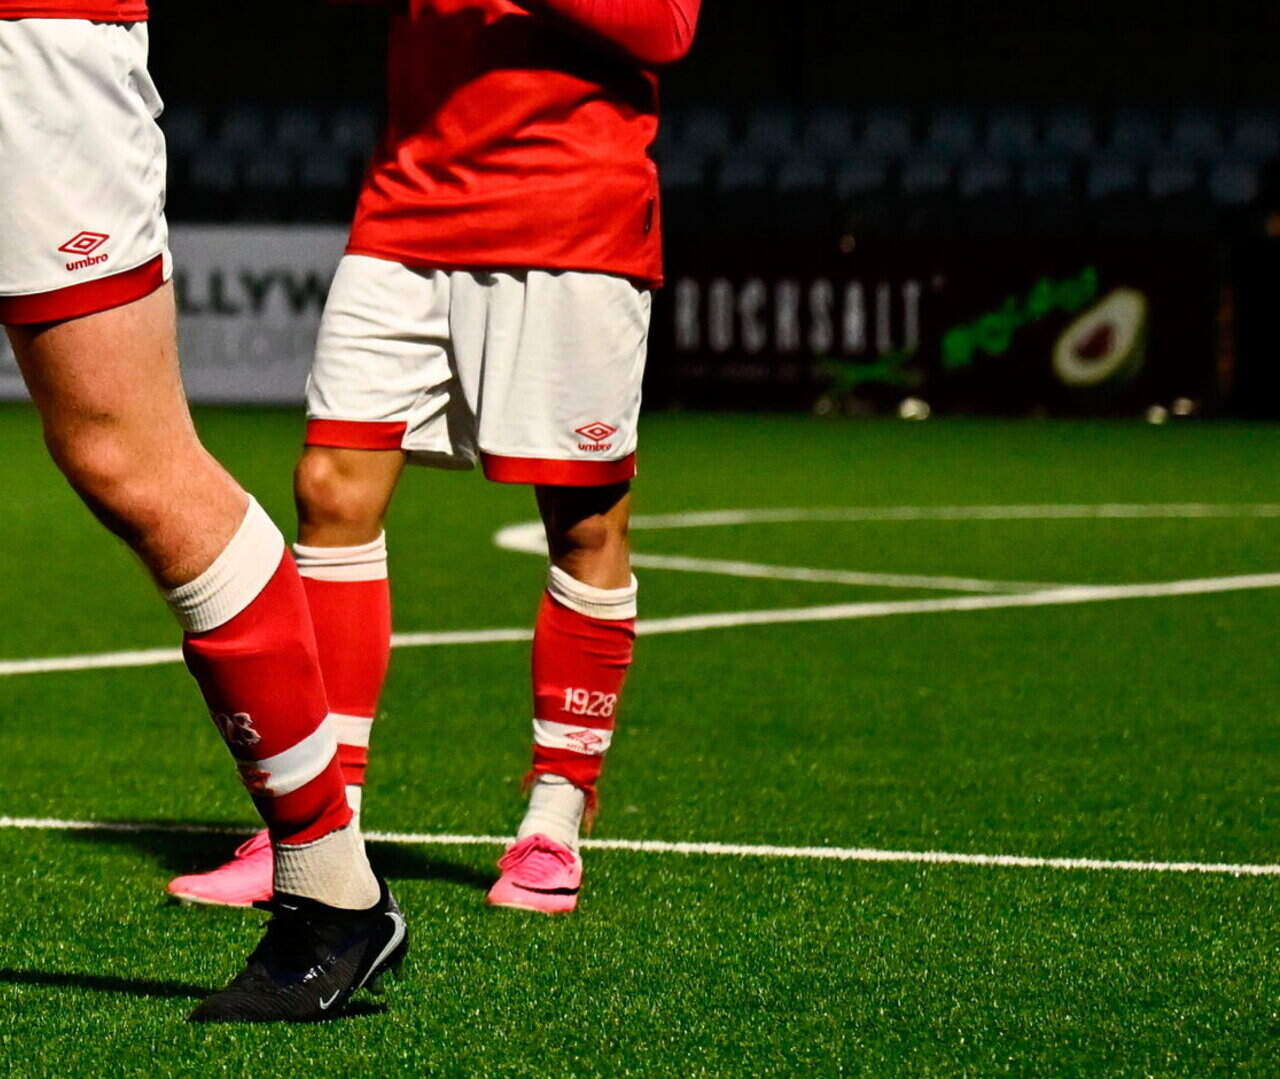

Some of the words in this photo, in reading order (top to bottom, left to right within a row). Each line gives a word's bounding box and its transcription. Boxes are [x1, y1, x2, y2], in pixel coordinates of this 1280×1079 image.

[65, 253, 109, 272] umbro
[673, 274, 921, 356] ROCKSALT
[578, 442, 613, 452] umbro
[560, 687, 618, 719] 1928
